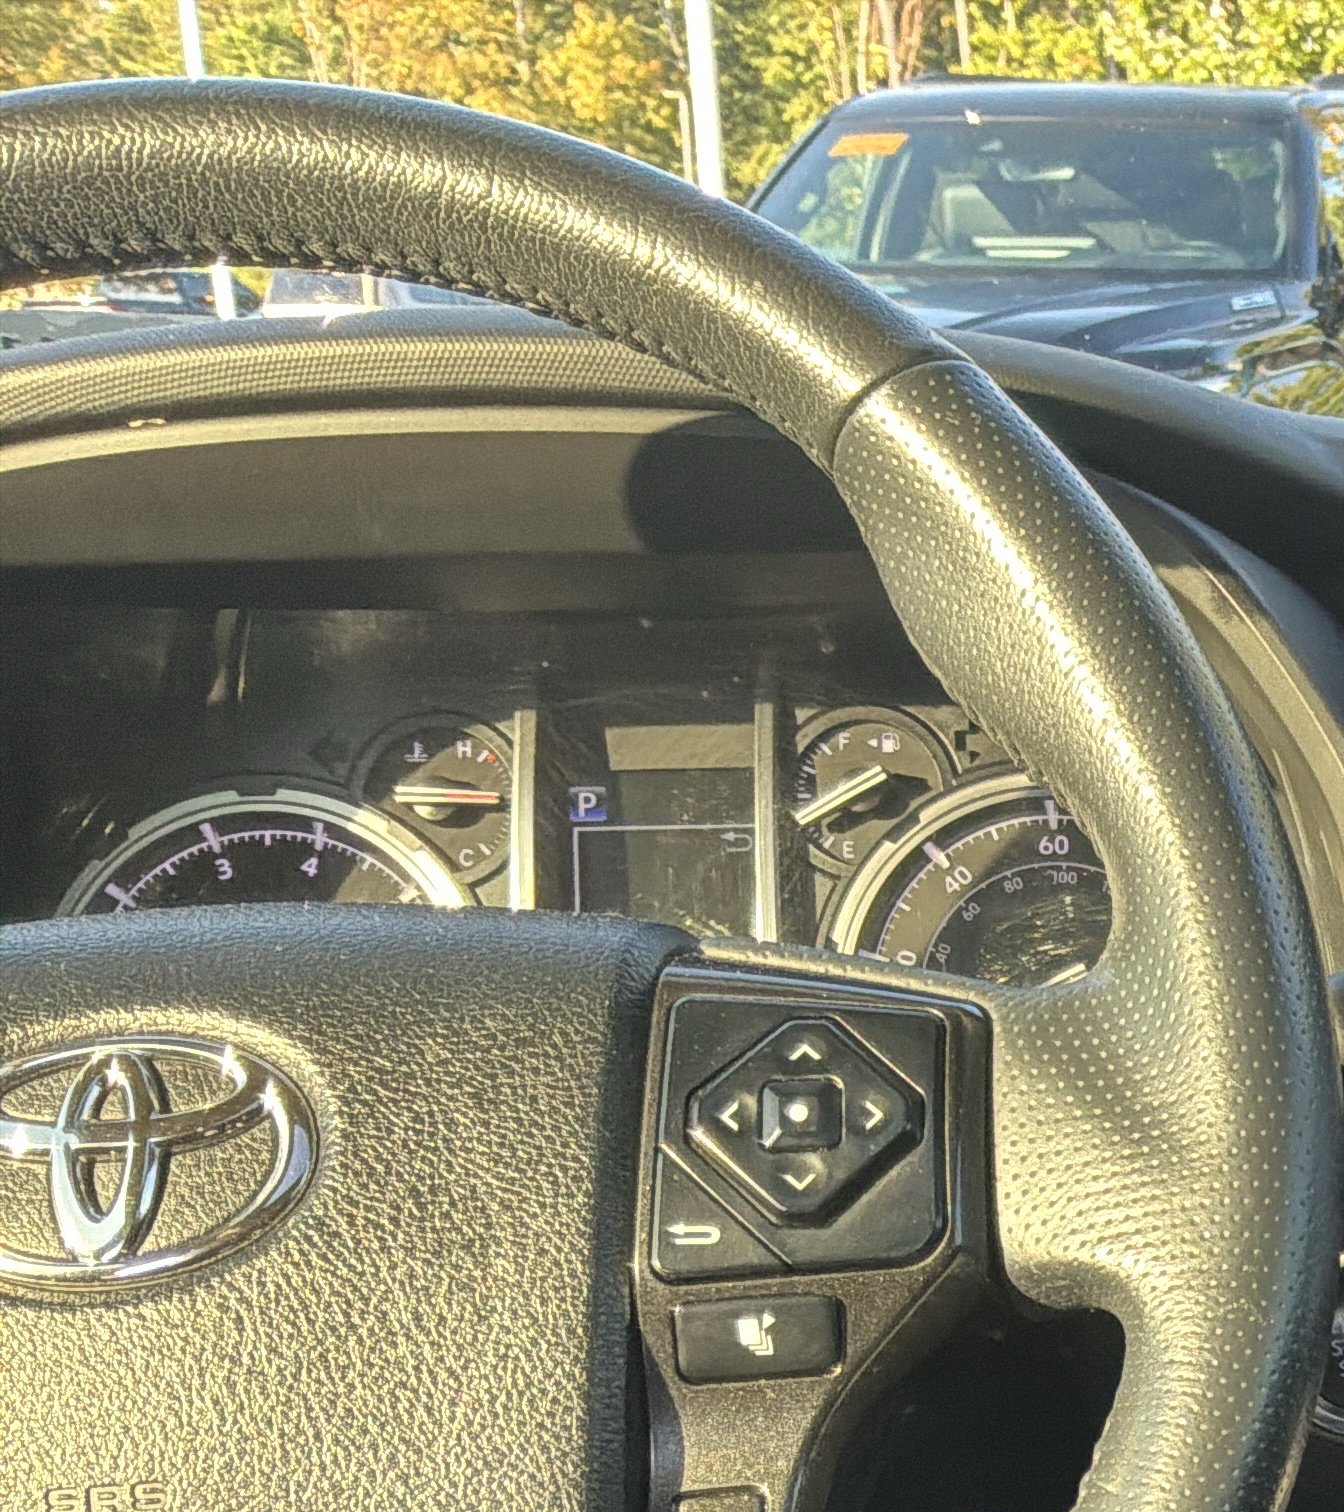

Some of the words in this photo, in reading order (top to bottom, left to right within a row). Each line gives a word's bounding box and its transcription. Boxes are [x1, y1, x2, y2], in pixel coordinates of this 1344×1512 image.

[456, 740, 472, 757] H
[837, 733, 851, 751] F
[578, 793, 597, 814] P
[842, 839, 856, 860] E
[1038, 834, 1070, 855] 60
[300, 856, 318, 877] 4
[458, 848, 474, 866] C
[214, 858, 234, 881] 3
[944, 865, 973, 894] 40
[1003, 876, 1024, 893] 80
[961, 902, 982, 922] 60
